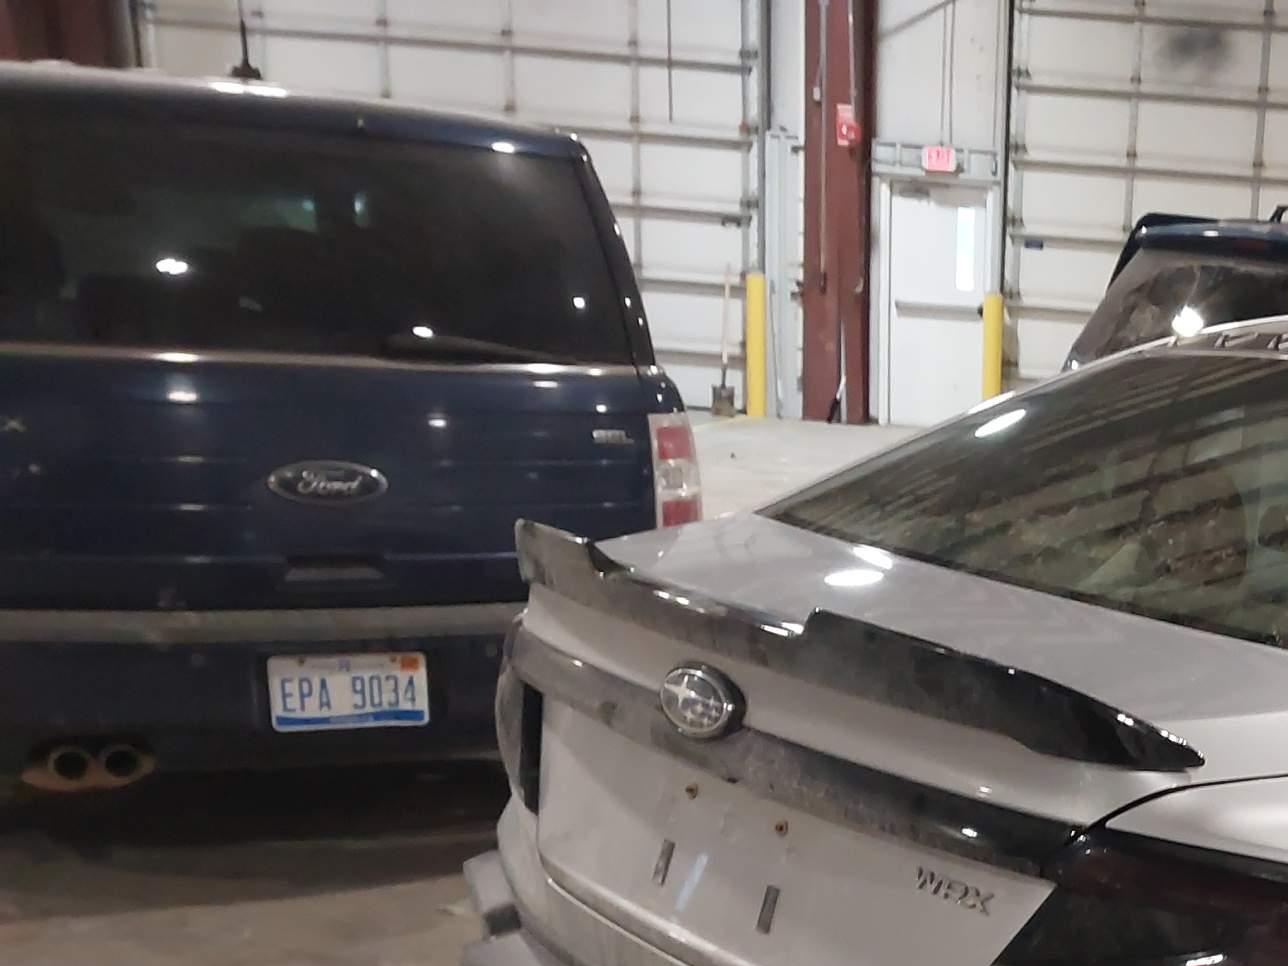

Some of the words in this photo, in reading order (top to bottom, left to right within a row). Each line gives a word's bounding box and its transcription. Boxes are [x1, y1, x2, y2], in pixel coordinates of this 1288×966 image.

[297, 470, 362, 495] Ford
[280, 677, 333, 713] EPA
[352, 675, 416, 710] 9034
[917, 866, 994, 916] WRX
